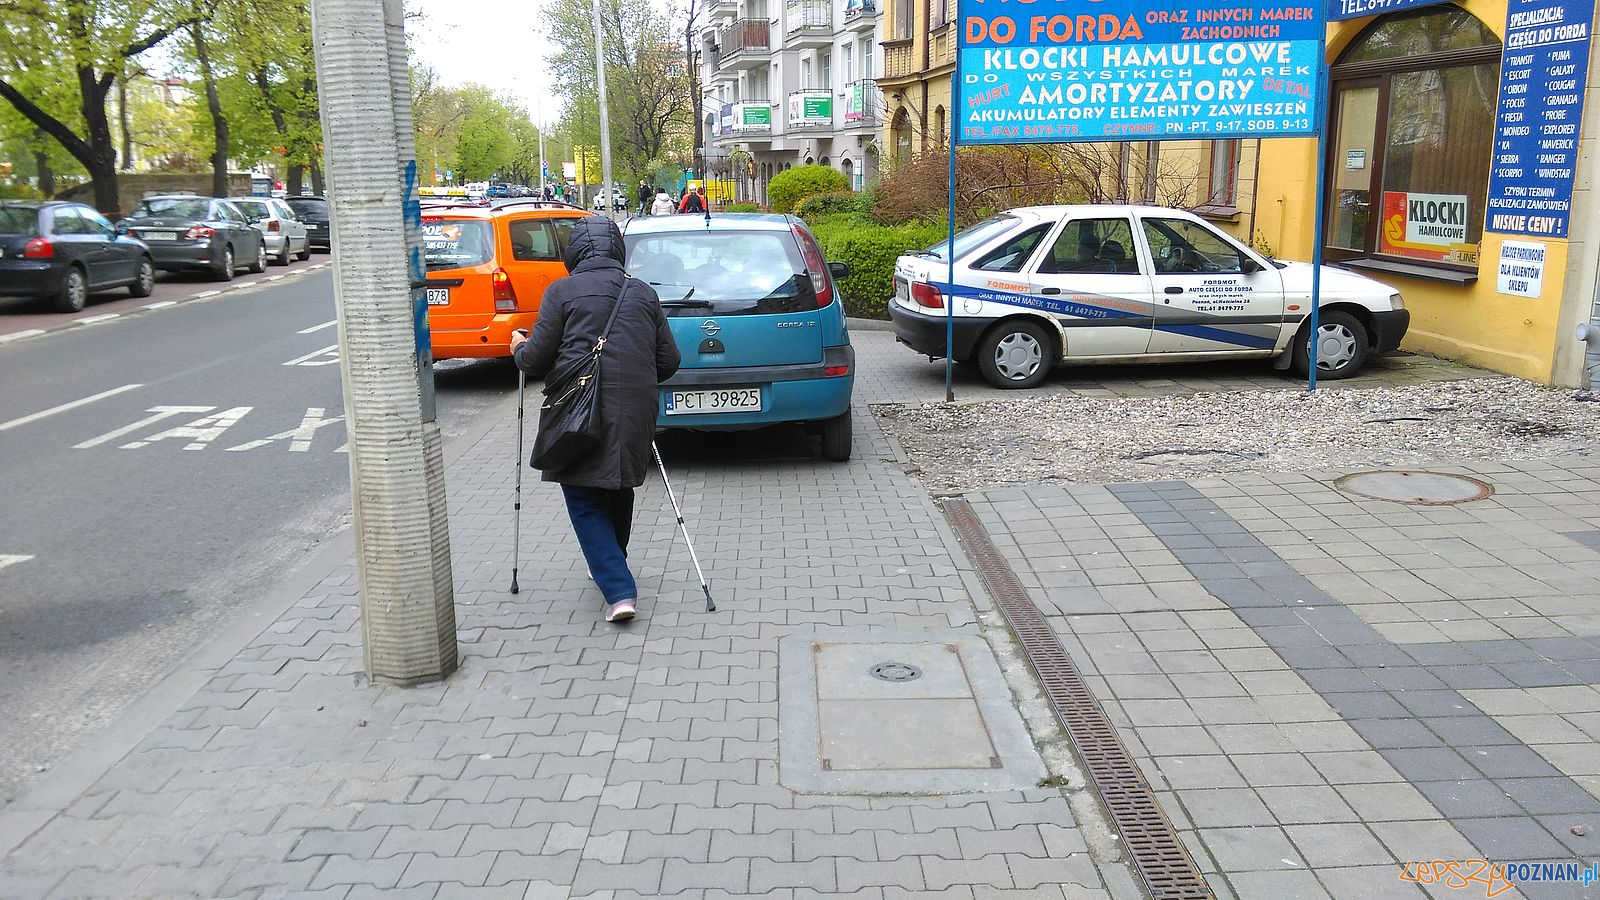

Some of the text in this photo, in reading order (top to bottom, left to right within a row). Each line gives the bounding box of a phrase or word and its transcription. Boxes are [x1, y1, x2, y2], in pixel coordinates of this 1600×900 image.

[1146, 7, 1313, 24] ORAZ INNYCH MAREK
[1509, 6, 1564, 28] SPECJALIZACJA:
[966, 13, 1144, 44] DO FORDA
[1181, 25, 1280, 40] ZACHODNICH
[1508, 23, 1586, 49] CZĘŚCI DO FORDA
[984, 42, 1291, 70] KLOCKI HAMULCOWE
[1509, 54, 1534, 66] TRANSIT
[965, 66, 1310, 84] DO WSZYSTKICH MAREK
[1508, 69, 1531, 80] ESCORT
[1550, 64, 1575, 76] GALAXY
[1018, 78, 1254, 105] AMORTYZATORY
[1263, 77, 1312, 98] DETAL
[1548, 79, 1576, 91] COUGAR
[968, 83, 1010, 109] HURT
[1506, 98, 1525, 108] FOCUS
[1547, 94, 1578, 106] GRANADA
[969, 100, 1307, 122] AKUMULATORY ELEMENTY ZAWIESZEŃ
[1545, 109, 1567, 120] PROBE
[1165, 122, 1184, 132] PN
[1247, 120, 1278, 130] SOB.
[1282, 118, 1309, 129] 9-13
[1502, 126, 1529, 136] MONDEO
[1543, 124, 1575, 135] EXPLORER
[1501, 140, 1510, 150] KA
[1541, 139, 1574, 149] MAVERICK
[1540, 153, 1566, 163] RANGER
[1498, 168, 1523, 178] SCORPIO
[1538, 168, 1571, 178] WINDSTAR
[1503, 187, 1555, 197] SZYBKI TERMIN
[1527, 198, 1569, 211] ZAMÓWIEŃ
[1409, 200, 1465, 225] KLOCKI
[1492, 214, 1526, 231] NISKIE
[1527, 216, 1556, 233] CENY
[1418, 225, 1464, 239] HAMULCOWE
[1500, 264, 1540, 279] DLA KLIENTÓW
[986, 280, 1031, 292] FORDMOT
[1508, 279, 1529, 293] SKLEPU
[995, 294, 1021, 304] INNYCH
[1021, 297, 1044, 307] MAREK
[674, 390, 759, 409] PCT 39825
[71, 405, 349, 453] TAX
